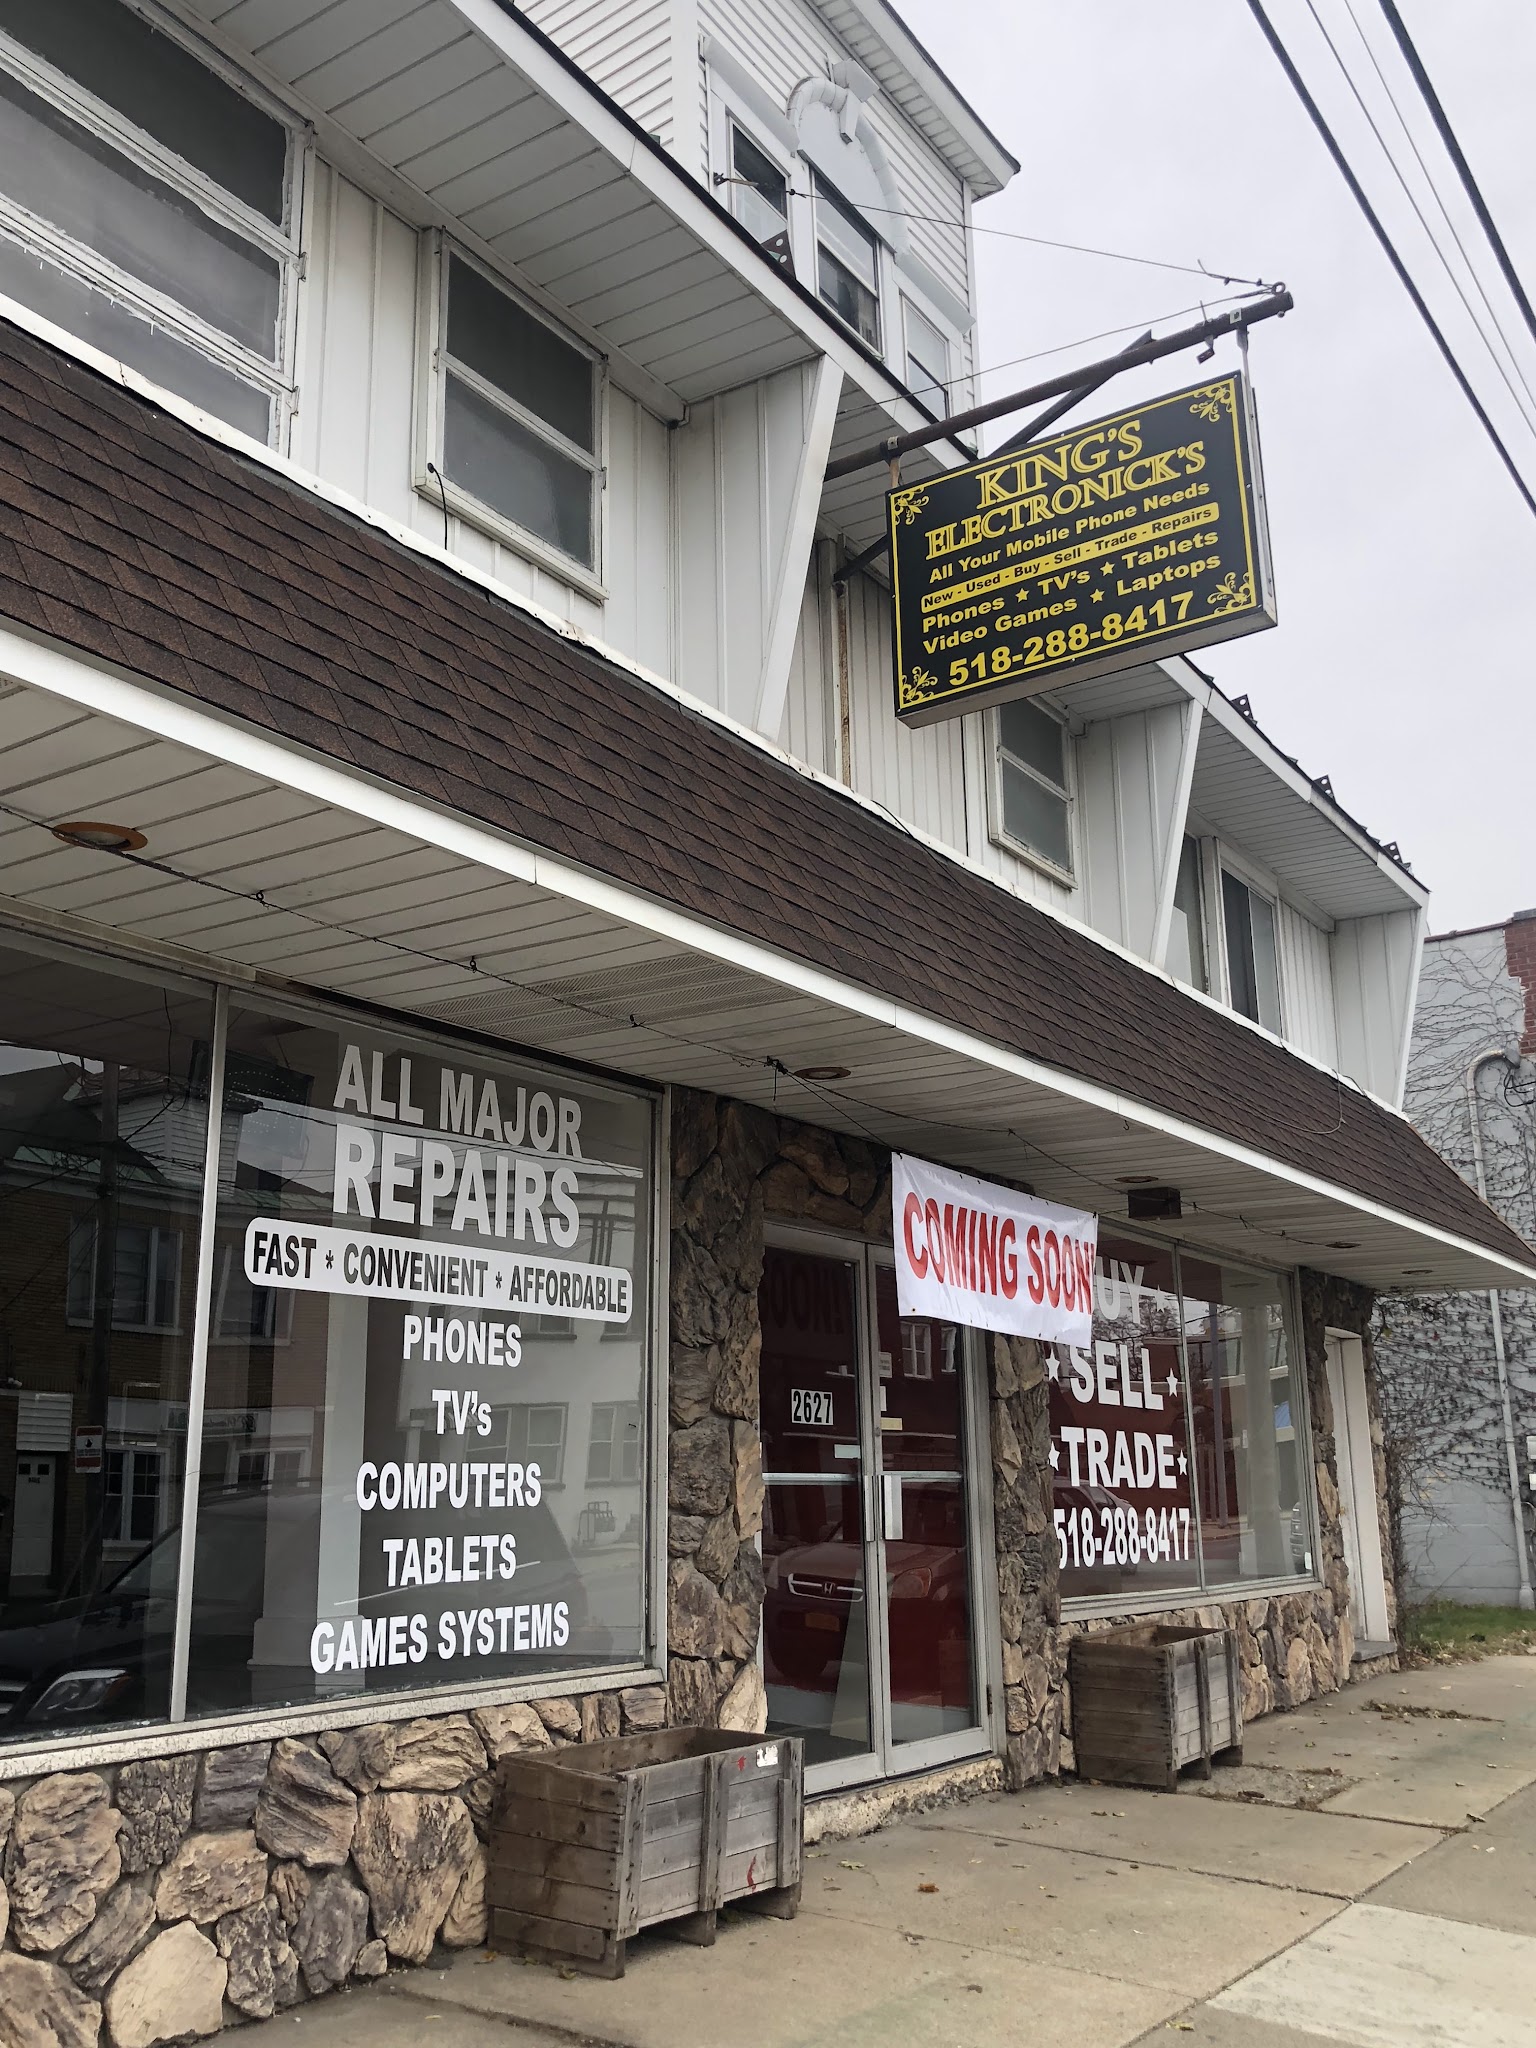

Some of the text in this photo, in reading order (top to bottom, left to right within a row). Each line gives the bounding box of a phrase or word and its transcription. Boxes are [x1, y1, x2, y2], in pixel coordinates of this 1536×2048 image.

[925, 441, 1206, 560] ELECTRONICK'S
[976, 420, 1143, 509] KING'S
[924, 591, 953, 608] New
[966, 574, 1001, 593] Used
[1014, 562, 1041, 578] Buy
[1053, 547, 1081, 564] Sell
[1095, 532, 1137, 551] Trade
[1151, 508, 1212, 534] Repairs
[929, 483, 1210, 583] All Your Mobile Phone Needs
[922, 532, 1219, 633] Phones TV's Tablets
[923, 555, 1221, 655] Video Games Laptops
[949, 591, 1195, 686] 518-288-8417
[333, 1044, 582, 1158] ALL MAJOR
[333, 1123, 580, 1248] REPAIRS
[252, 1231, 627, 1314] FAST CONVENIENT AFFORDABLE
[903, 1192, 1018, 1300] COMING
[1095, 1256, 1145, 1325] UY
[403, 1315, 522, 1367] PHONES
[1069, 1340, 1164, 1411] SELL
[432, 1389, 492, 1436] TV's
[792, 1391, 832, 1424] 2627
[356, 1462, 542, 1511] COMPUTERS
[1060, 1426, 1177, 1489] TRADE
[382, 1533, 516, 1587] TABLETS
[1053, 1507, 1190, 1569] 518-288-8417
[310, 1601, 570, 1674] GAMES SYSTEMS
